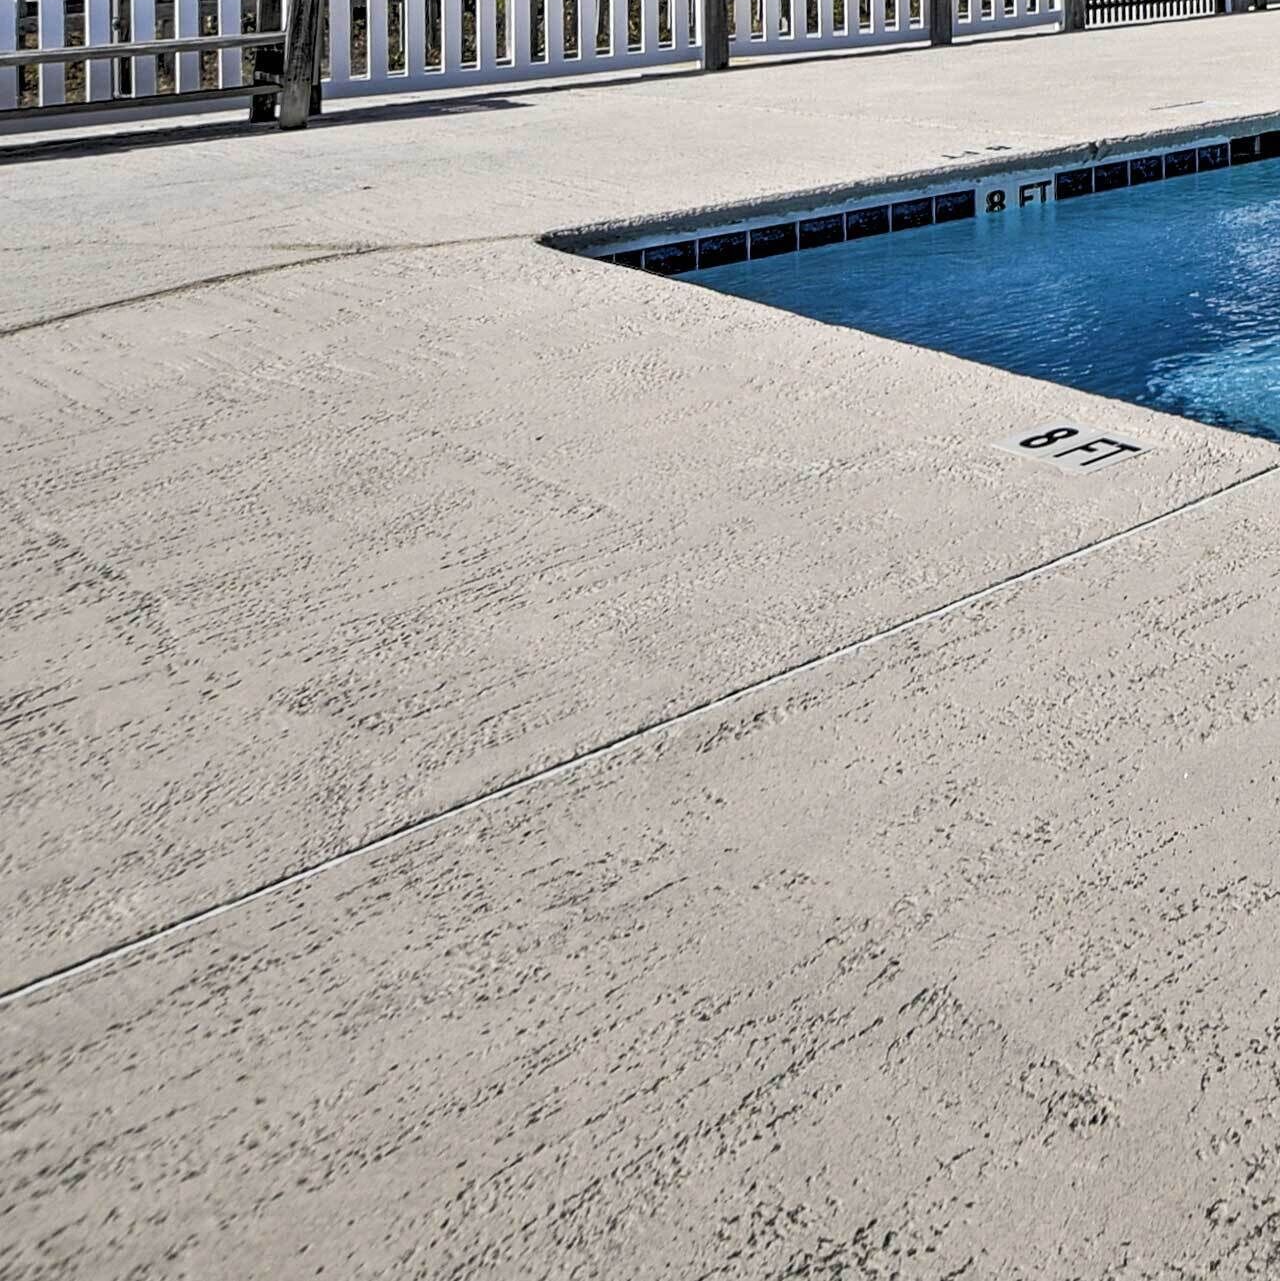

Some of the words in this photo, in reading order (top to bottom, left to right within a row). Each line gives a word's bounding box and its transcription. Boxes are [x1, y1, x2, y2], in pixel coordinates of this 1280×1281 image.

[985, 189, 1006, 213] 8
[1019, 180, 1052, 208] FT
[1019, 427, 1079, 449] 8
[1053, 437, 1142, 466] FT
